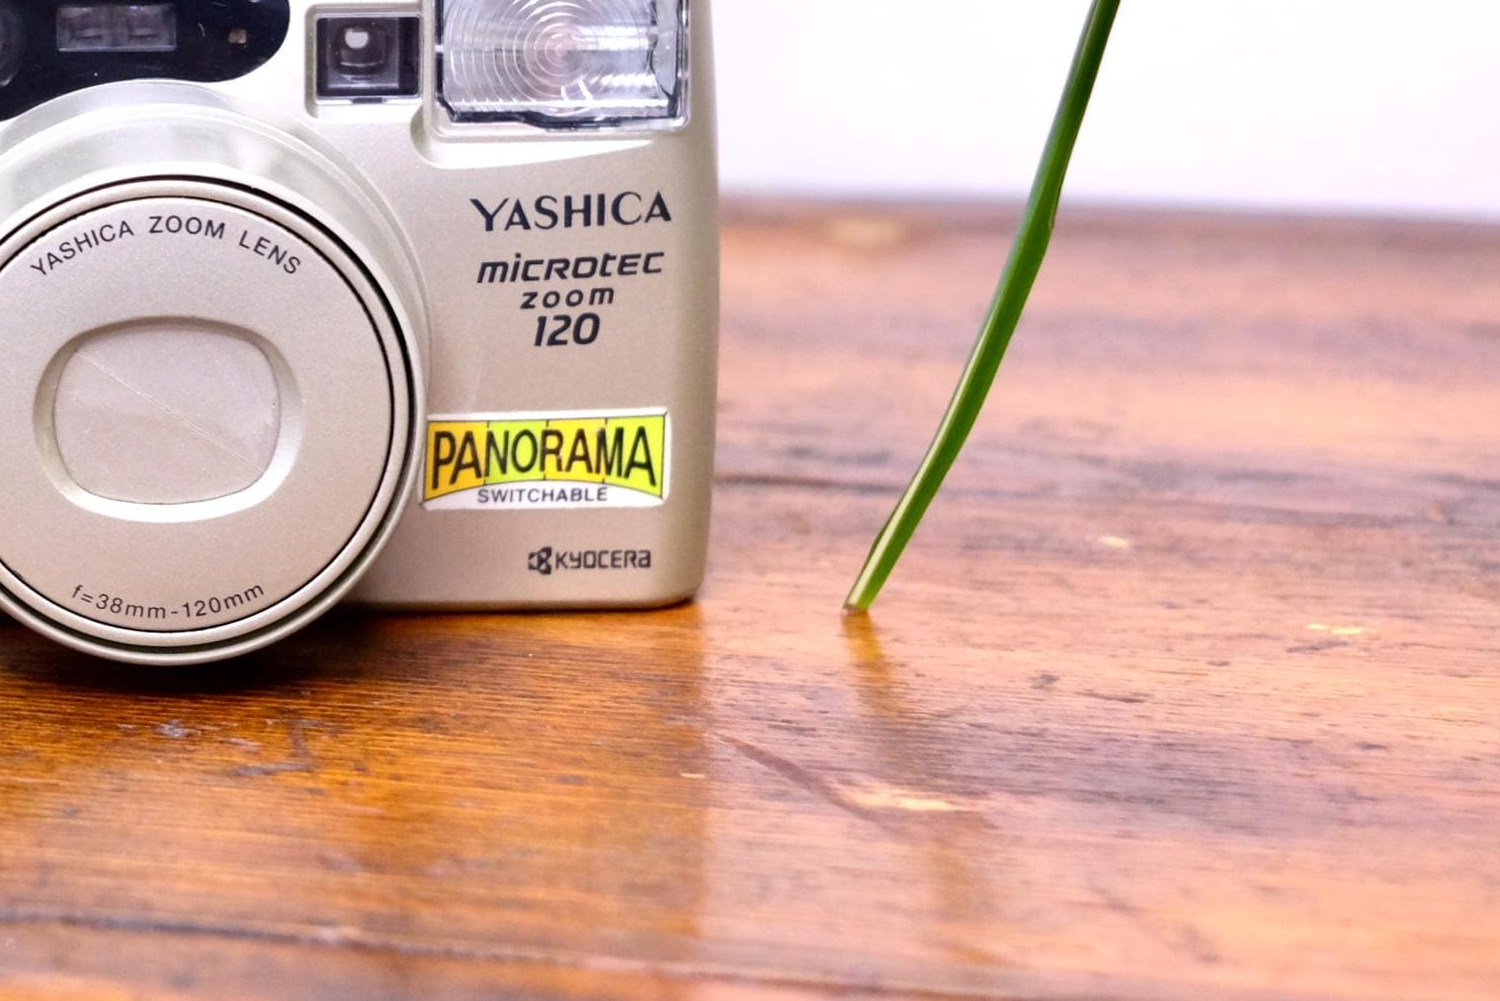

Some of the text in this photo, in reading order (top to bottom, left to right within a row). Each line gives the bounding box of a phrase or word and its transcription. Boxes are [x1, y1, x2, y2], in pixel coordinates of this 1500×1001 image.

[469, 190, 672, 232] YASHICA
[30, 214, 302, 277] YASHICA ZOOM LENS
[520, 287, 615, 309] zoom
[534, 312, 601, 347] 120
[431, 425, 657, 491] PANORAMA
[477, 486, 608, 505] SWITCHABLE
[555, 549, 651, 570] KYOCERA
